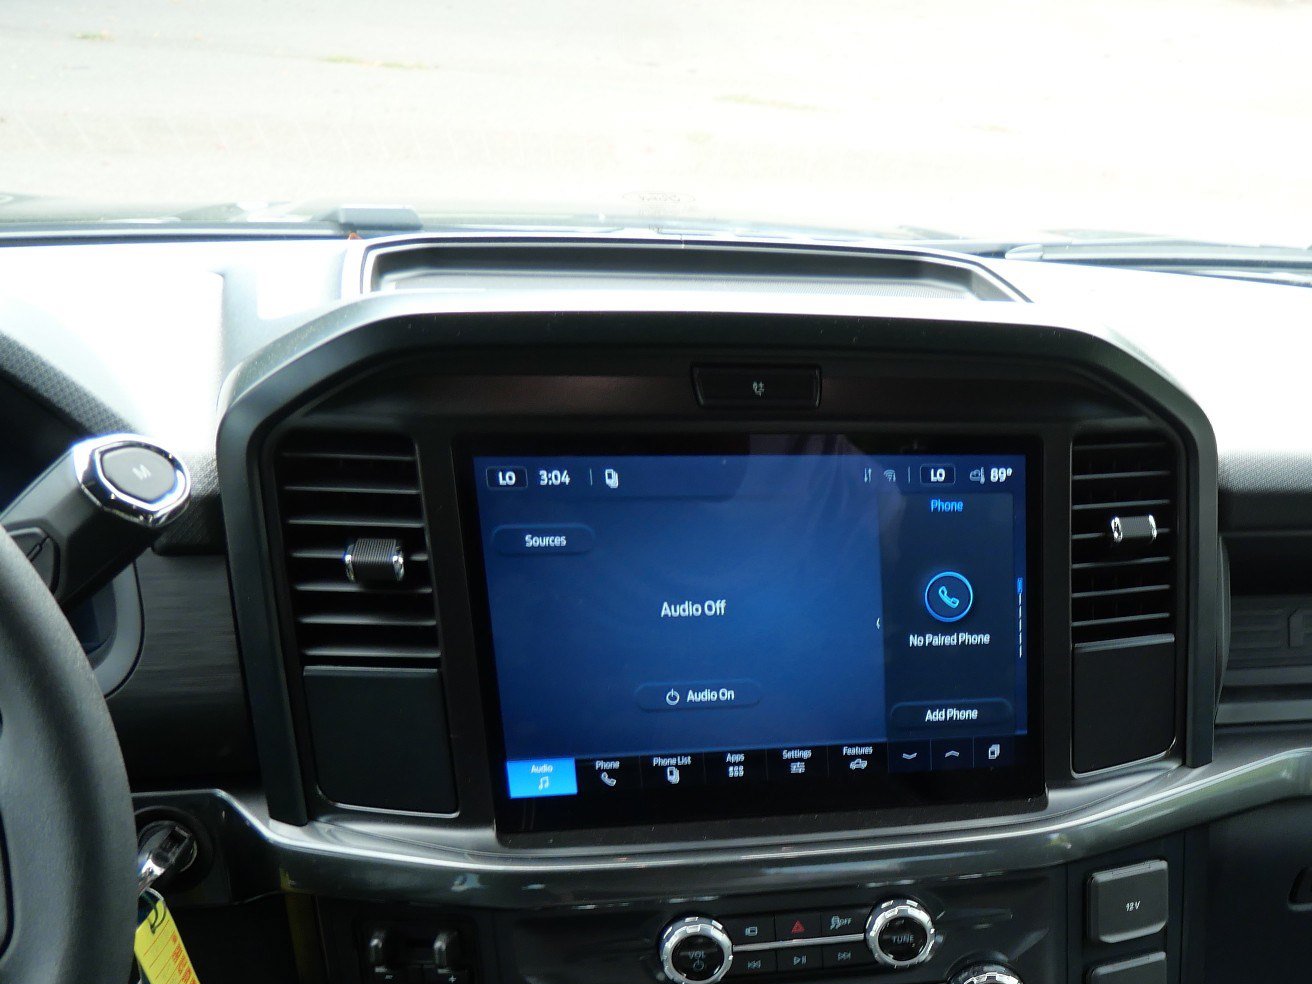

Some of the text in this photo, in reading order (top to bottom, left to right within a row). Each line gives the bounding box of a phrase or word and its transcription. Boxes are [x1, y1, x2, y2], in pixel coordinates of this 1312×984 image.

[498, 471, 516, 486] LO
[539, 469, 571, 486] 3:04
[930, 469, 946, 483] LO
[931, 499, 964, 513] Phone
[525, 534, 567, 548] Sources
[661, 600, 726, 618] Audio Off
[909, 632, 991, 648] No Paired Phone
[687, 687, 735, 703] Audio On
[925, 708, 978, 723] Add Phone
[783, 749, 811, 761] Settings
[843, 745, 873, 756] Features
[653, 756, 692, 767] Phone List
[726, 753, 745, 763] Apps
[531, 764, 554, 775] Audio
[596, 760, 620, 771] Phone
